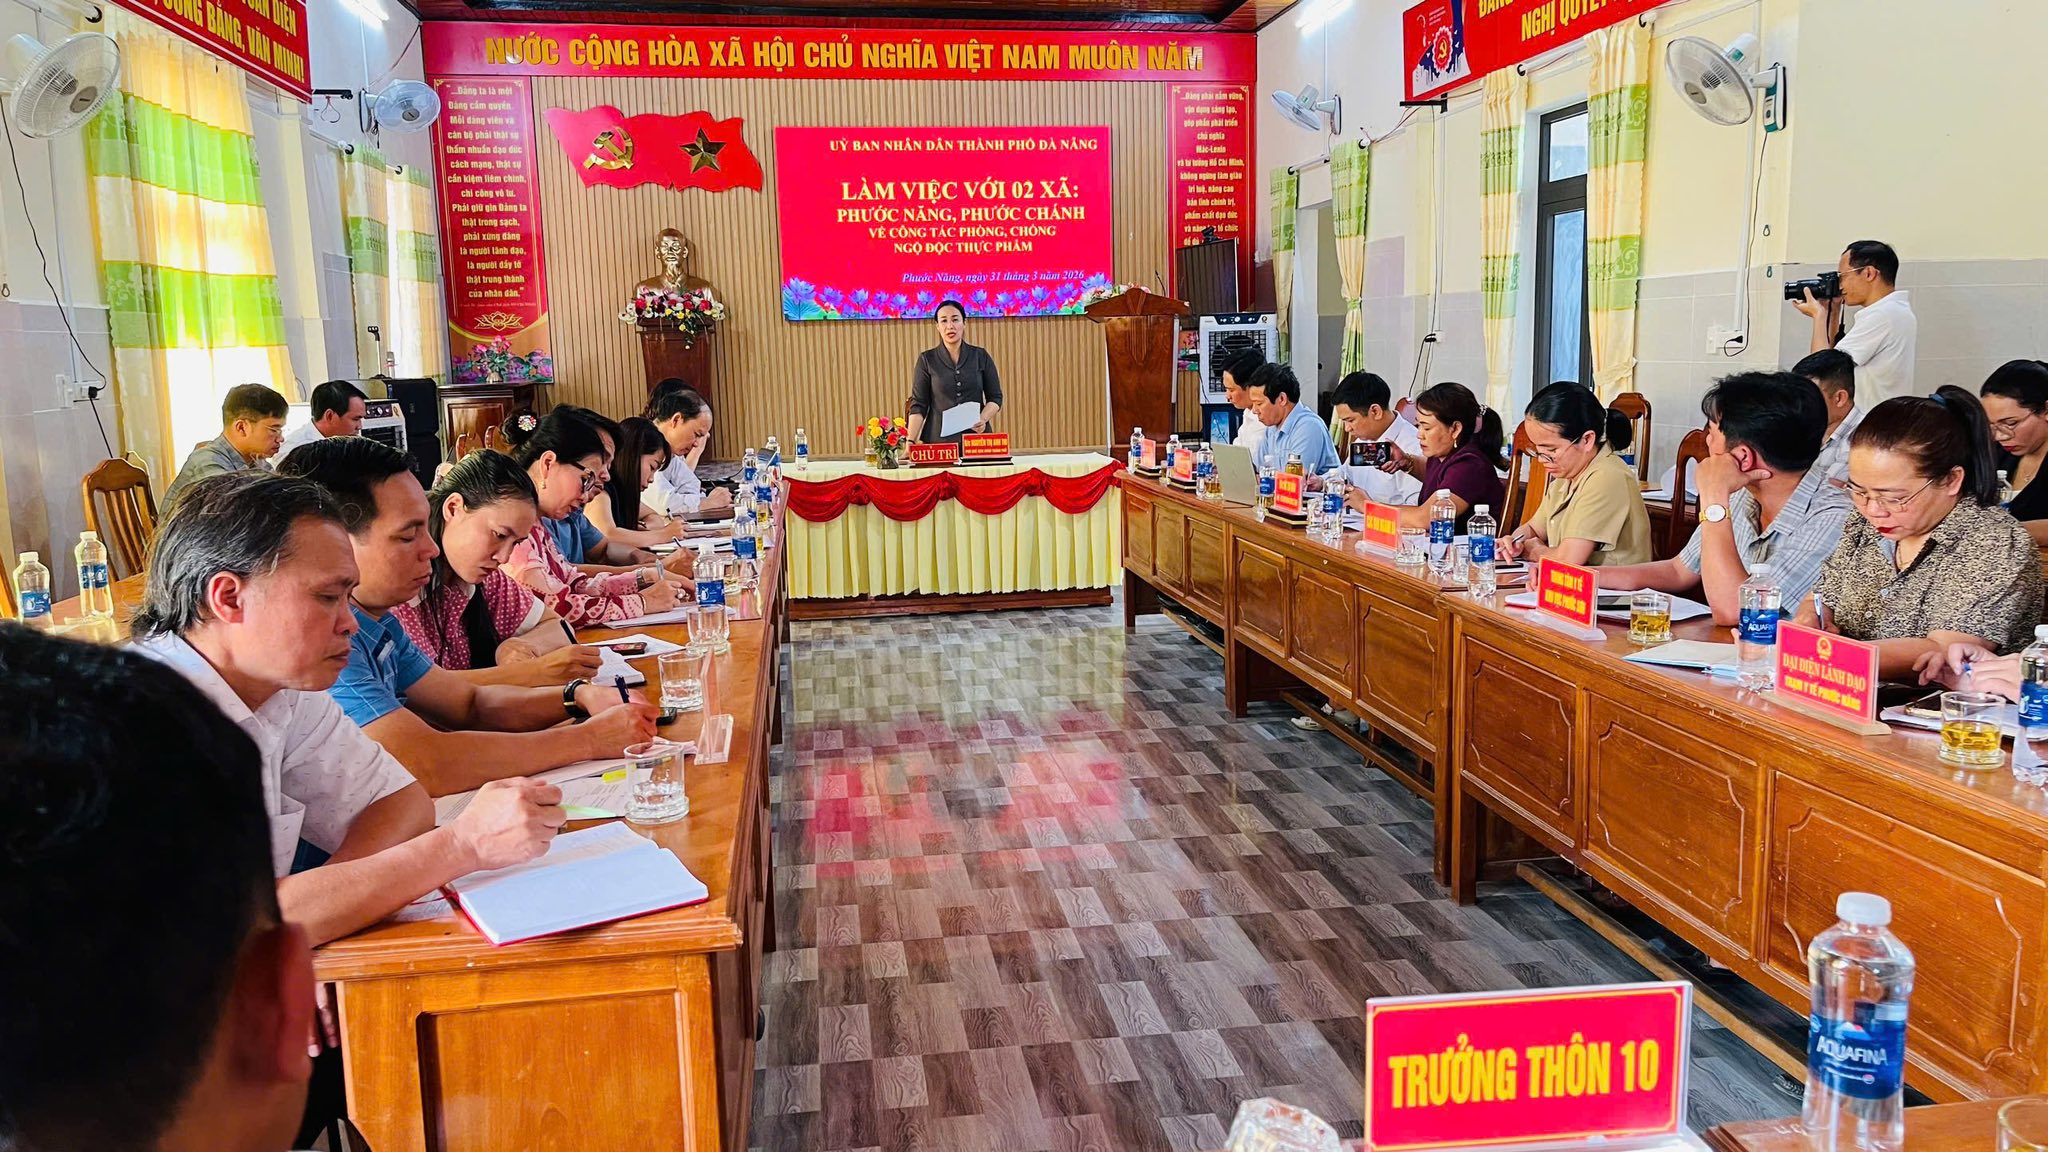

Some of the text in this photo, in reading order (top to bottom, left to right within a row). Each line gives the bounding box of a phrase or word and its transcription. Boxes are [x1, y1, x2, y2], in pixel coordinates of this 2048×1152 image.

[1521, 0, 1555, 42] NGHỊ
[247, 25, 271, 64] VĂN
[273, 40, 304, 83] MINH!
[484, 31, 1203, 73] NƯỚC CỘNG HÒA XÃ HỘI CHỦ NGHĨA VIỆT NAM MUÔN NĂM
[830, 138, 850, 151] UỶ
[853, 140, 880, 151] BAN
[883, 138, 923, 151] NHÂN
[926, 138, 953, 151] DÂN
[956, 138, 1004, 151] THÀNH
[1039, 137, 1057, 150] ĐÀ
[841, 176, 1080, 204] LÀM VIỆC VỚI 02 XÃ:
[837, 204, 1085, 224] PHƯỚC NĂNG, PHƯỚC CHÁNH
[868, 224, 1056, 238] VỀ CÔNG TÁC PHÒNG, CHỐNG
[894, 240, 1033, 256] NGỘ ĐỘC THỰC PHẨM
[902, 270, 1084, 284] Phước Năng, ngày 31 tháng 3 năm 2026
[911, 446, 935, 461] CHỦ
[938, 445, 957, 460] TRÌ
[1821, 663, 1845, 685] LÃNH
[1846, 672, 1866, 693] ĐẠO
[1816, 1035, 1888, 1066] AQUAFINA
[1388, 1032, 1660, 1108] TRƯỞNG THÔN 10
